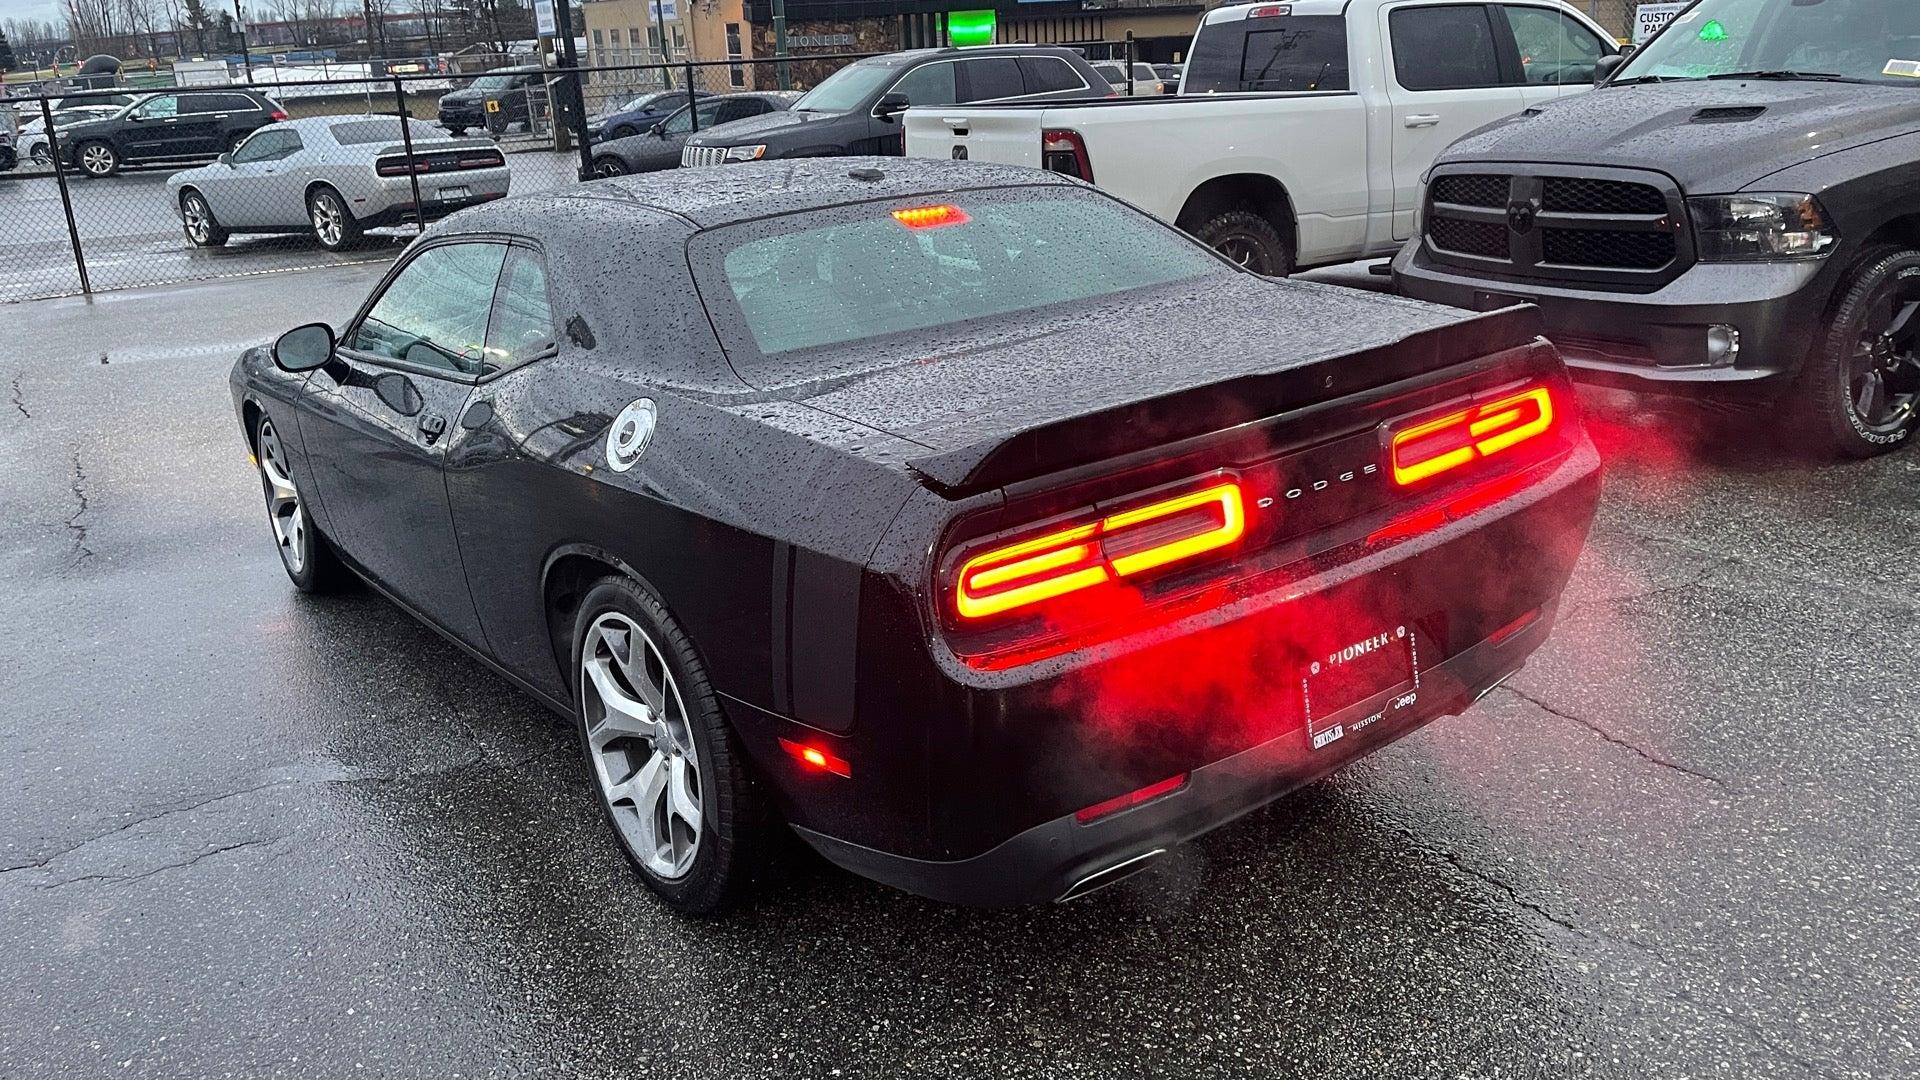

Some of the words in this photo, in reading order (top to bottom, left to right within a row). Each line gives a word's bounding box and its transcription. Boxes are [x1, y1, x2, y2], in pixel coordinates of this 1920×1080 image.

[1640, 12, 1675, 23] CUSTO
[786, 34, 849, 47] PIONEER
[1257, 463, 1377, 508] DODGE
[1329, 632, 1389, 664] PIONEER
[1395, 692, 1417, 710] Jeep
[1352, 713, 1382, 732] MISSION
